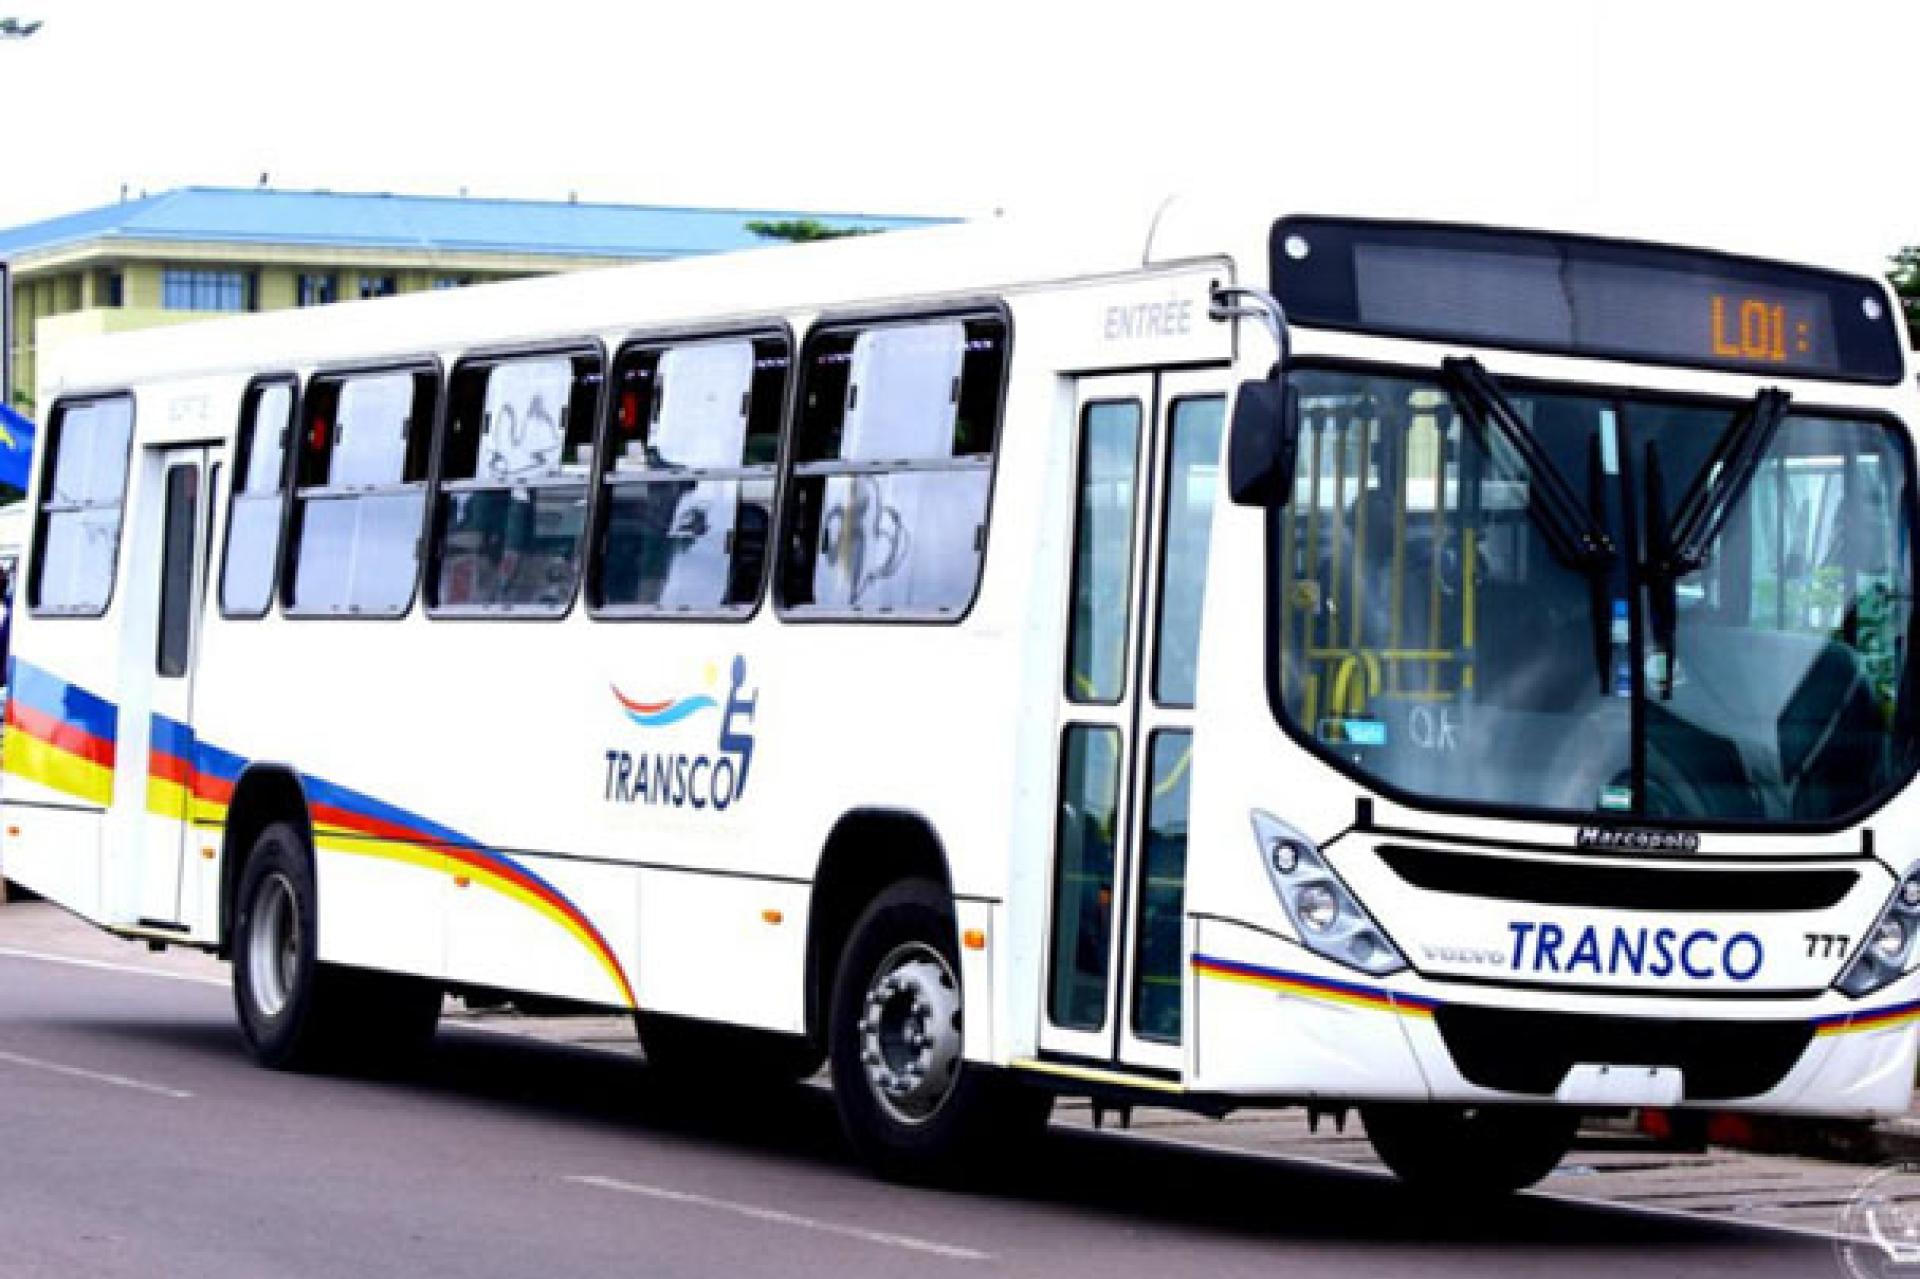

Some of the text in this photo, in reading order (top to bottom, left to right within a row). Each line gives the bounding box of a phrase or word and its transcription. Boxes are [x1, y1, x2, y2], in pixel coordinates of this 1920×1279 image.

[605, 750, 734, 811] TRANSCO
[1507, 921, 1764, 980] TRANSCO
[1803, 932, 1850, 958] 777
